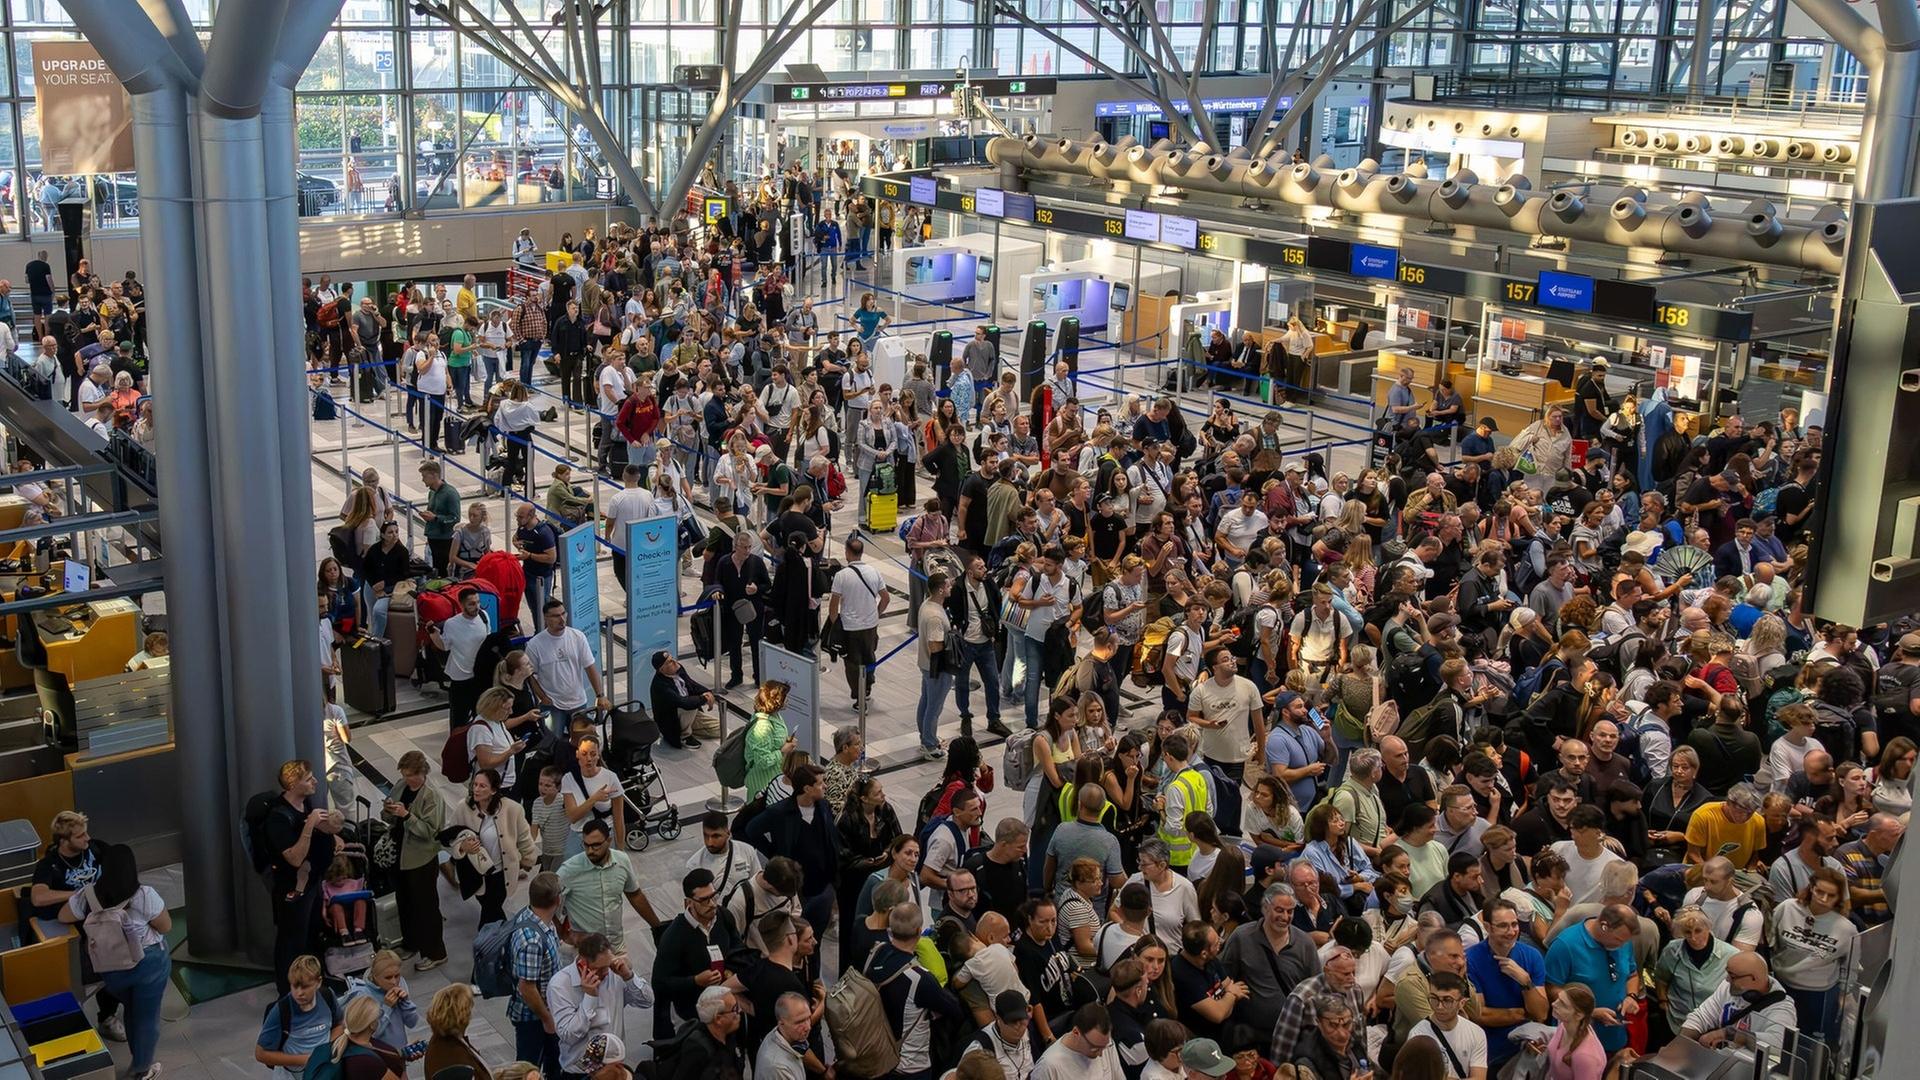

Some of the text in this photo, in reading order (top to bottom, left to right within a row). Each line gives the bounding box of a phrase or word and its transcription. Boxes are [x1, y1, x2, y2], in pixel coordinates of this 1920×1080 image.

[42, 59, 106, 71] UPGRADE
[376, 53, 392, 67] P5
[42, 72, 114, 85] YOUR SEAT.
[884, 184, 897, 196] 150
[961, 198, 974, 212] 151
[1037, 209, 1053, 224] 152
[1104, 219, 1122, 235] 153
[1199, 234, 1218, 249] 154
[1282, 247, 1305, 265] 155
[1400, 266, 1425, 284] 156
[1506, 282, 1534, 301] 157
[1557, 286, 1582, 295] STUTTGART
[1657, 305, 1688, 327] 158
[1552, 503, 1575, 515] adidas
[637, 550, 671, 561] Check-in
